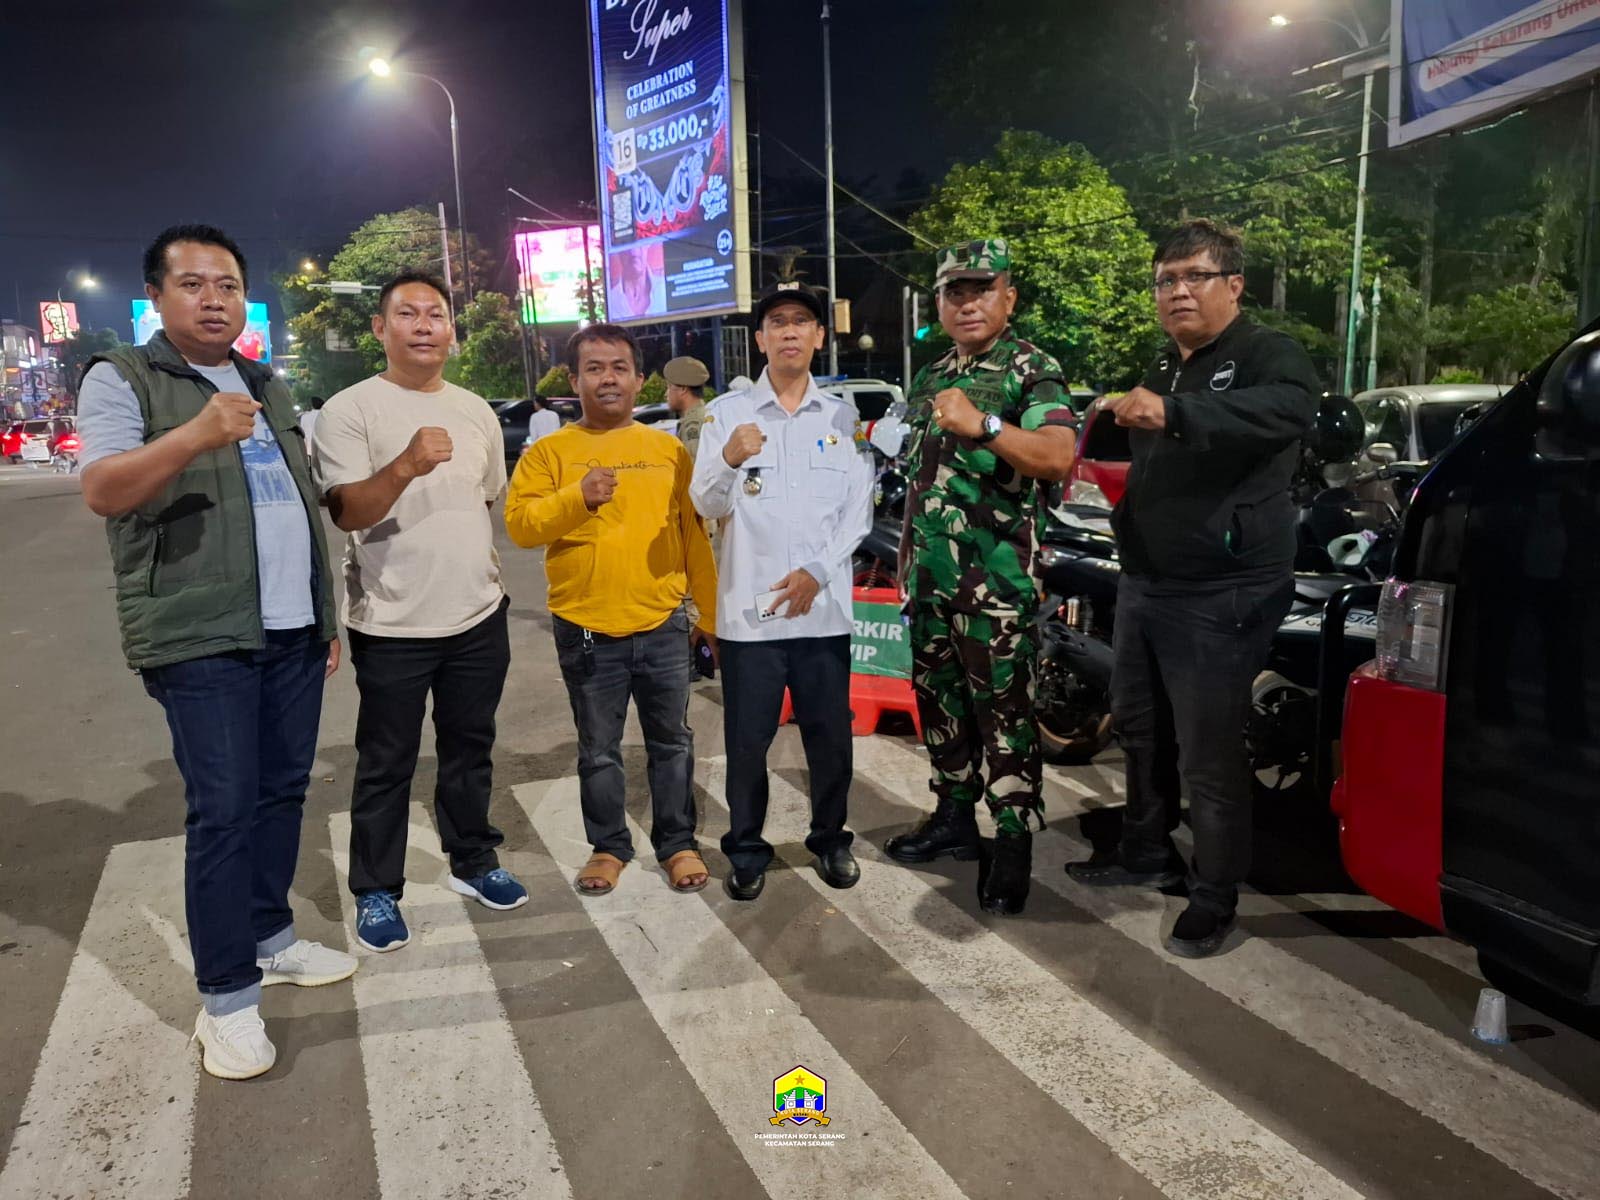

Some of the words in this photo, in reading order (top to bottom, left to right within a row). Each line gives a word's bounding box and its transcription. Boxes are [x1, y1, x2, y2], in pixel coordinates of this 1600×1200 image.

[623, 0, 692, 66] Super
[1482, 15, 1552, 52] Sekarang
[626, 60, 694, 101] CELEBRATION
[626, 104, 639, 120] OF
[640, 79, 697, 114] GREATNESS
[618, 136, 632, 161] 16
[852, 620, 903, 641] RKIR
